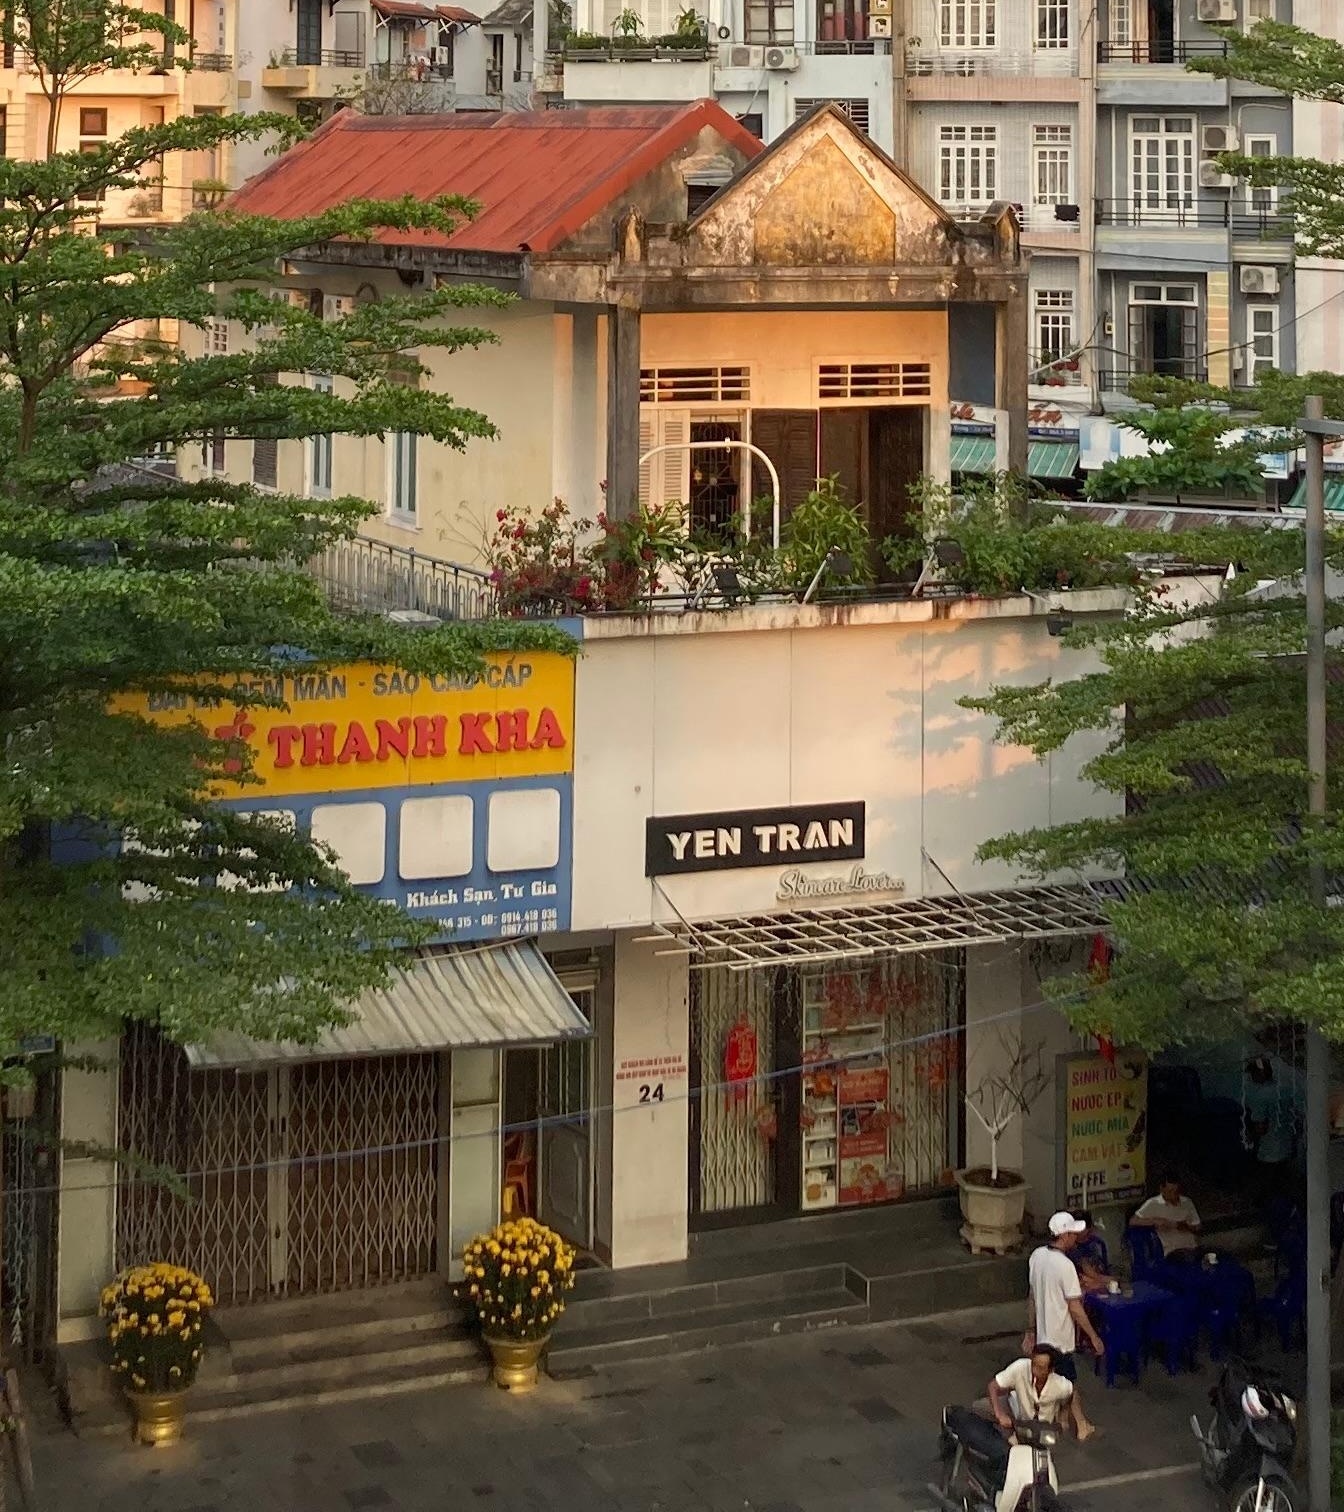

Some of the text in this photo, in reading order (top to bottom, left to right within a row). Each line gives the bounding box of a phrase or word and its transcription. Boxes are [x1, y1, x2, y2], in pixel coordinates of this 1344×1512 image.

[268, 716, 448, 768] THANH
[458, 707, 567, 755] KHA
[666, 819, 853, 861] YEN TRAN
[407, 888, 458, 908] Khách
[531, 880, 557, 896] Gia
[639, 1083, 664, 1103] 24
